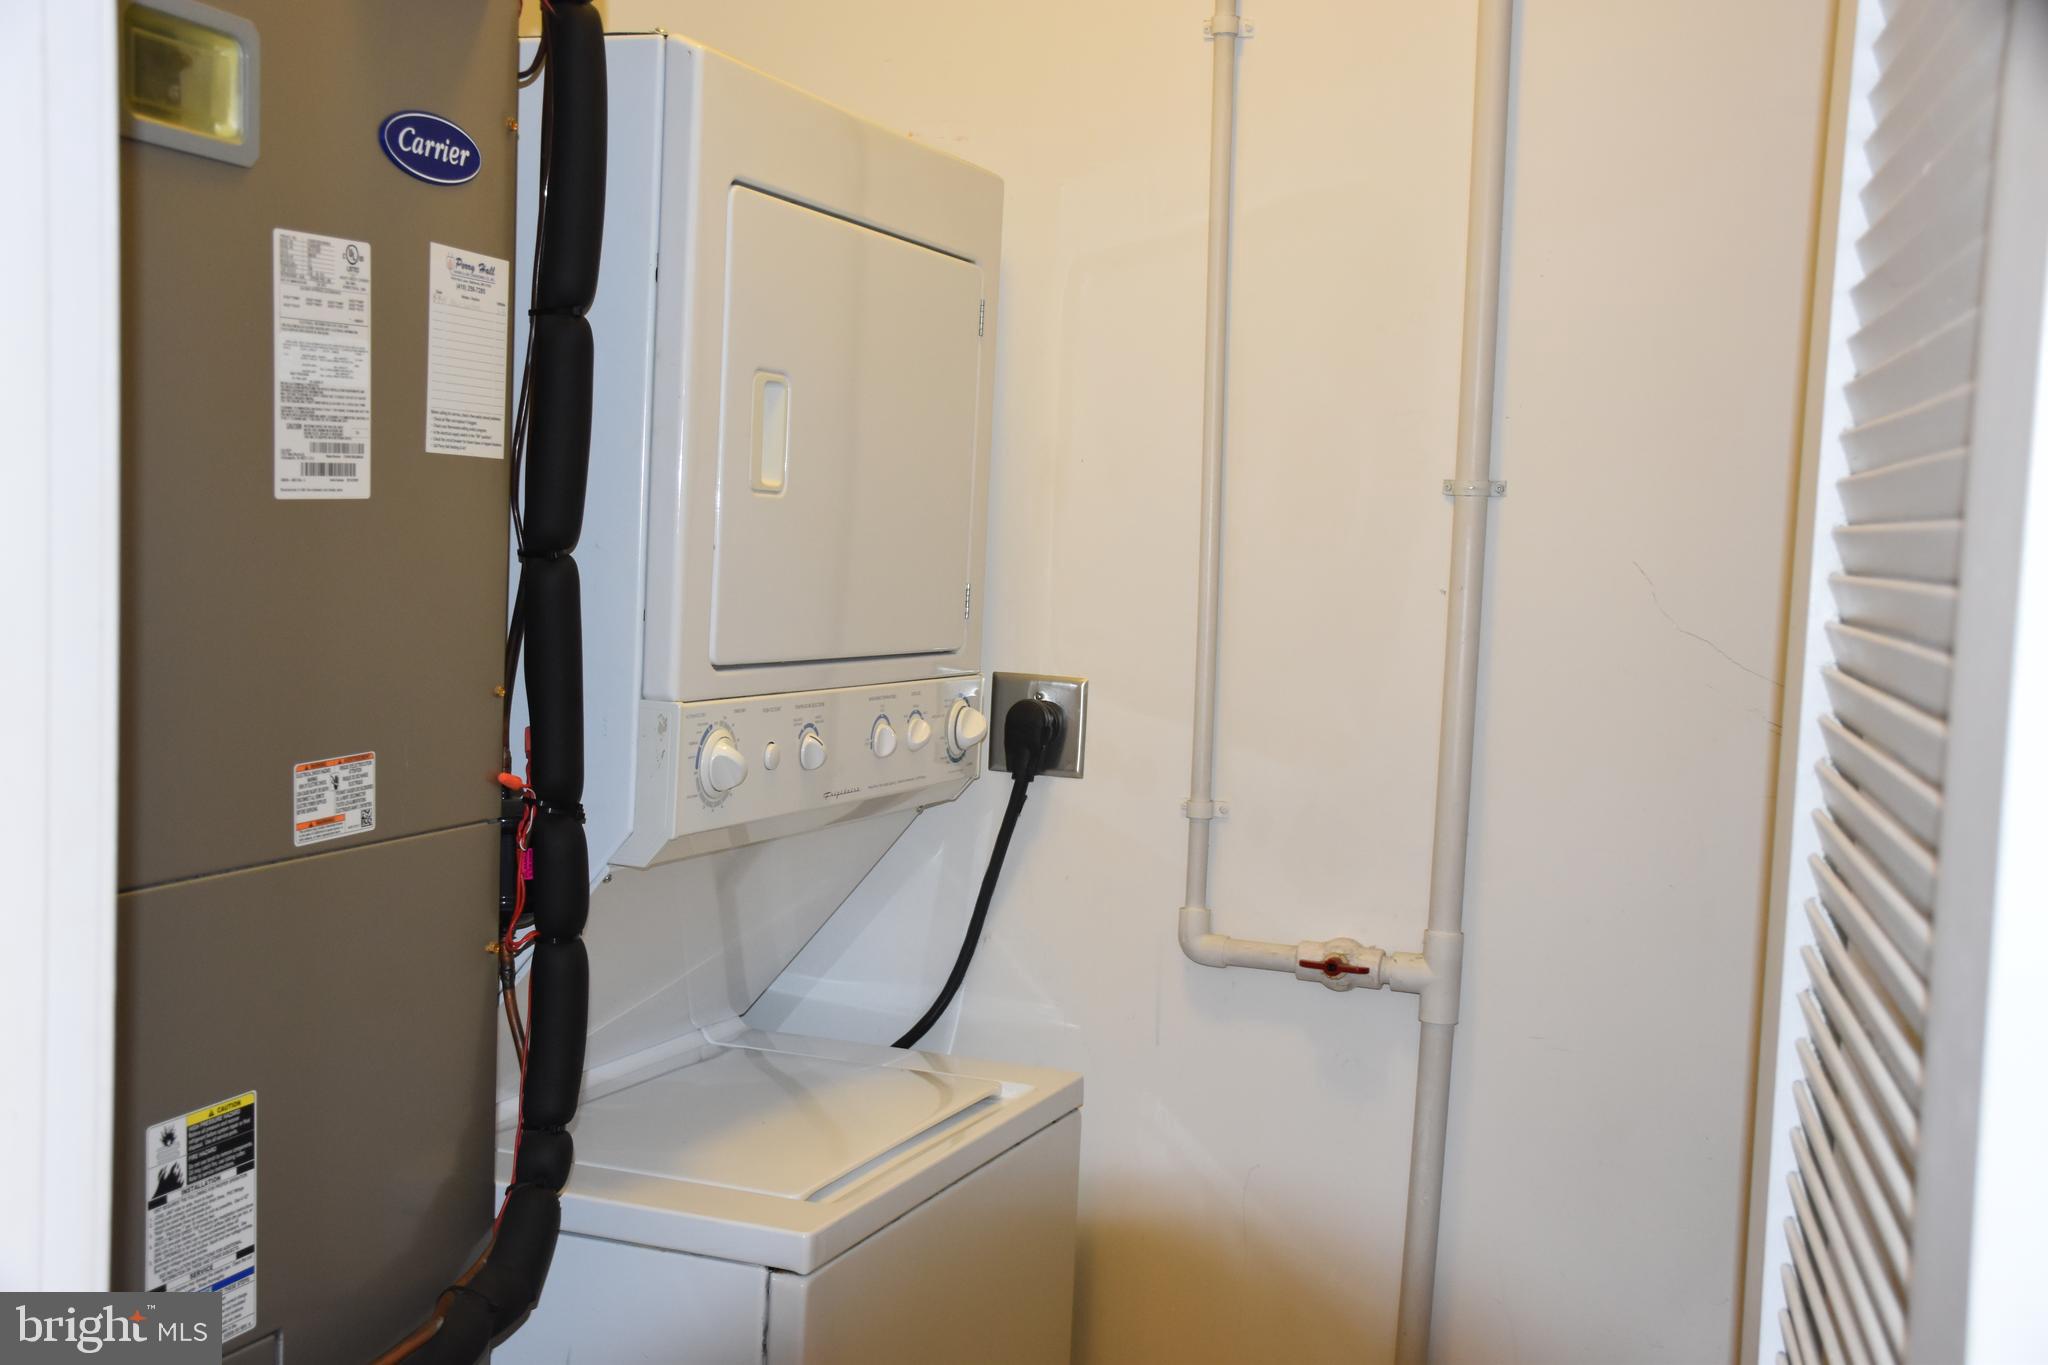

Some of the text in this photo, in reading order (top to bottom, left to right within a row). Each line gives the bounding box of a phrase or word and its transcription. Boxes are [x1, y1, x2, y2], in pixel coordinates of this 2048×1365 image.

[398, 127, 470, 167] Carrier
[456, 257, 496, 276] Perry Hall
[217, 1100, 241, 1114] CAUTION
[181, 1176, 221, 1195] INSTALLATION
[190, 1264, 213, 1280] SERVICE
